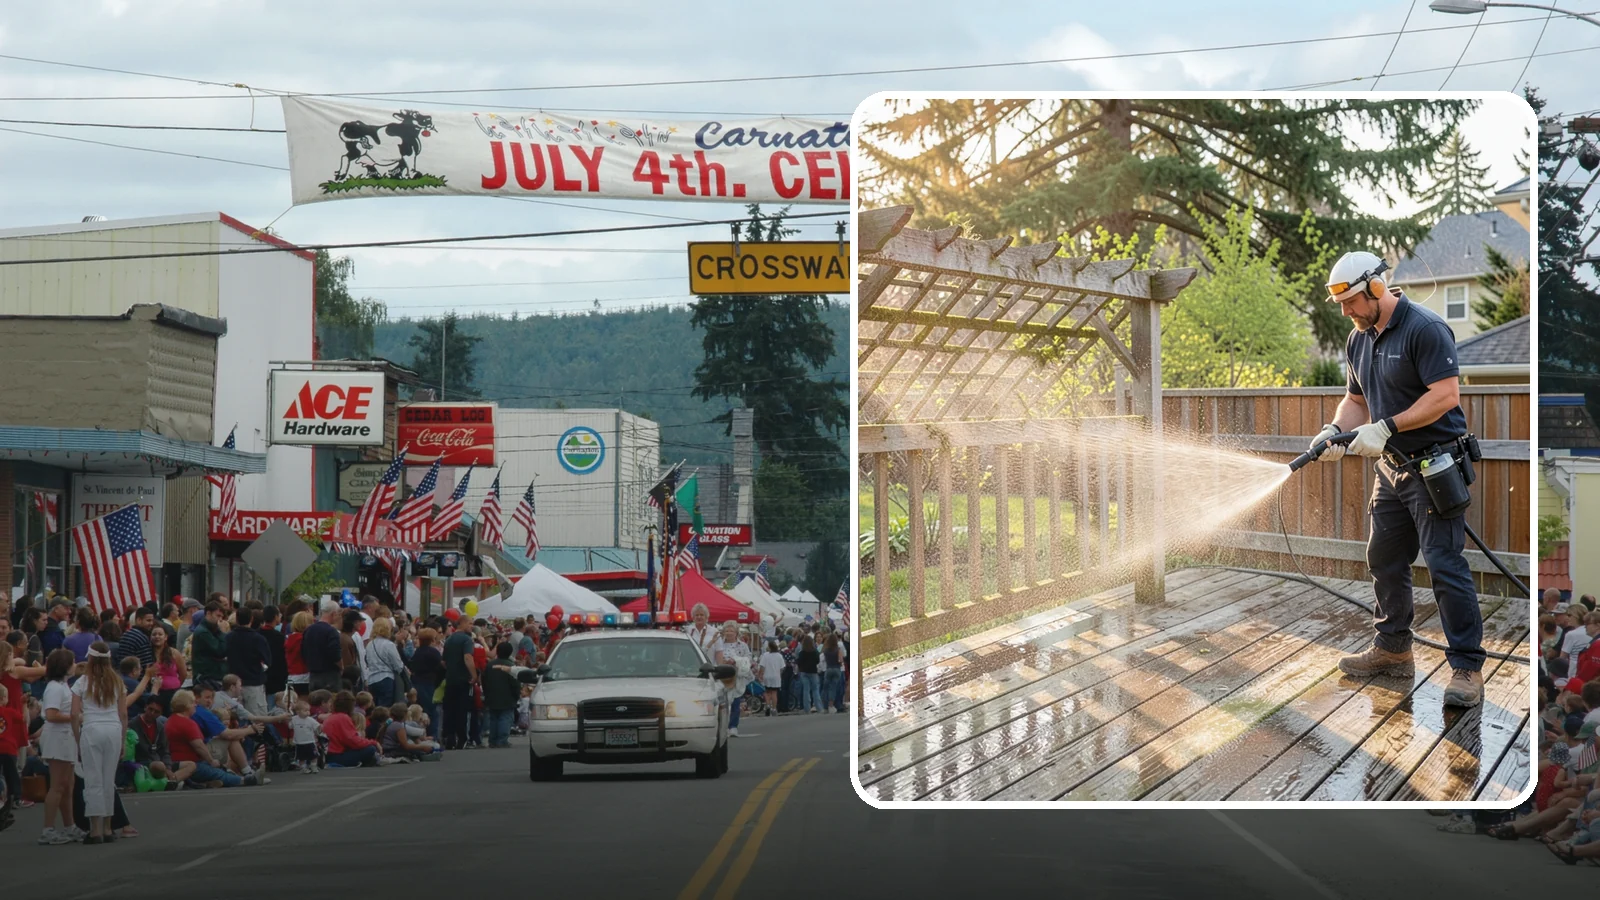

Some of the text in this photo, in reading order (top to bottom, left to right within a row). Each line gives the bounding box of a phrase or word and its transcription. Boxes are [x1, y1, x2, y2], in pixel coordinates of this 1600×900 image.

[481, 141, 605, 192] JULY
[632, 150, 746, 197] 4th.
[283, 380, 373, 420] ACE
[406, 409, 452, 422] CEDAR
[283, 421, 371, 437] Hardware
[96, 485, 124, 495] Vincent
[126, 486, 136, 495] de
[138, 486, 155, 495] Paul
[688, 526, 741, 535] CRNATION
[699, 535, 730, 543] GLASS
